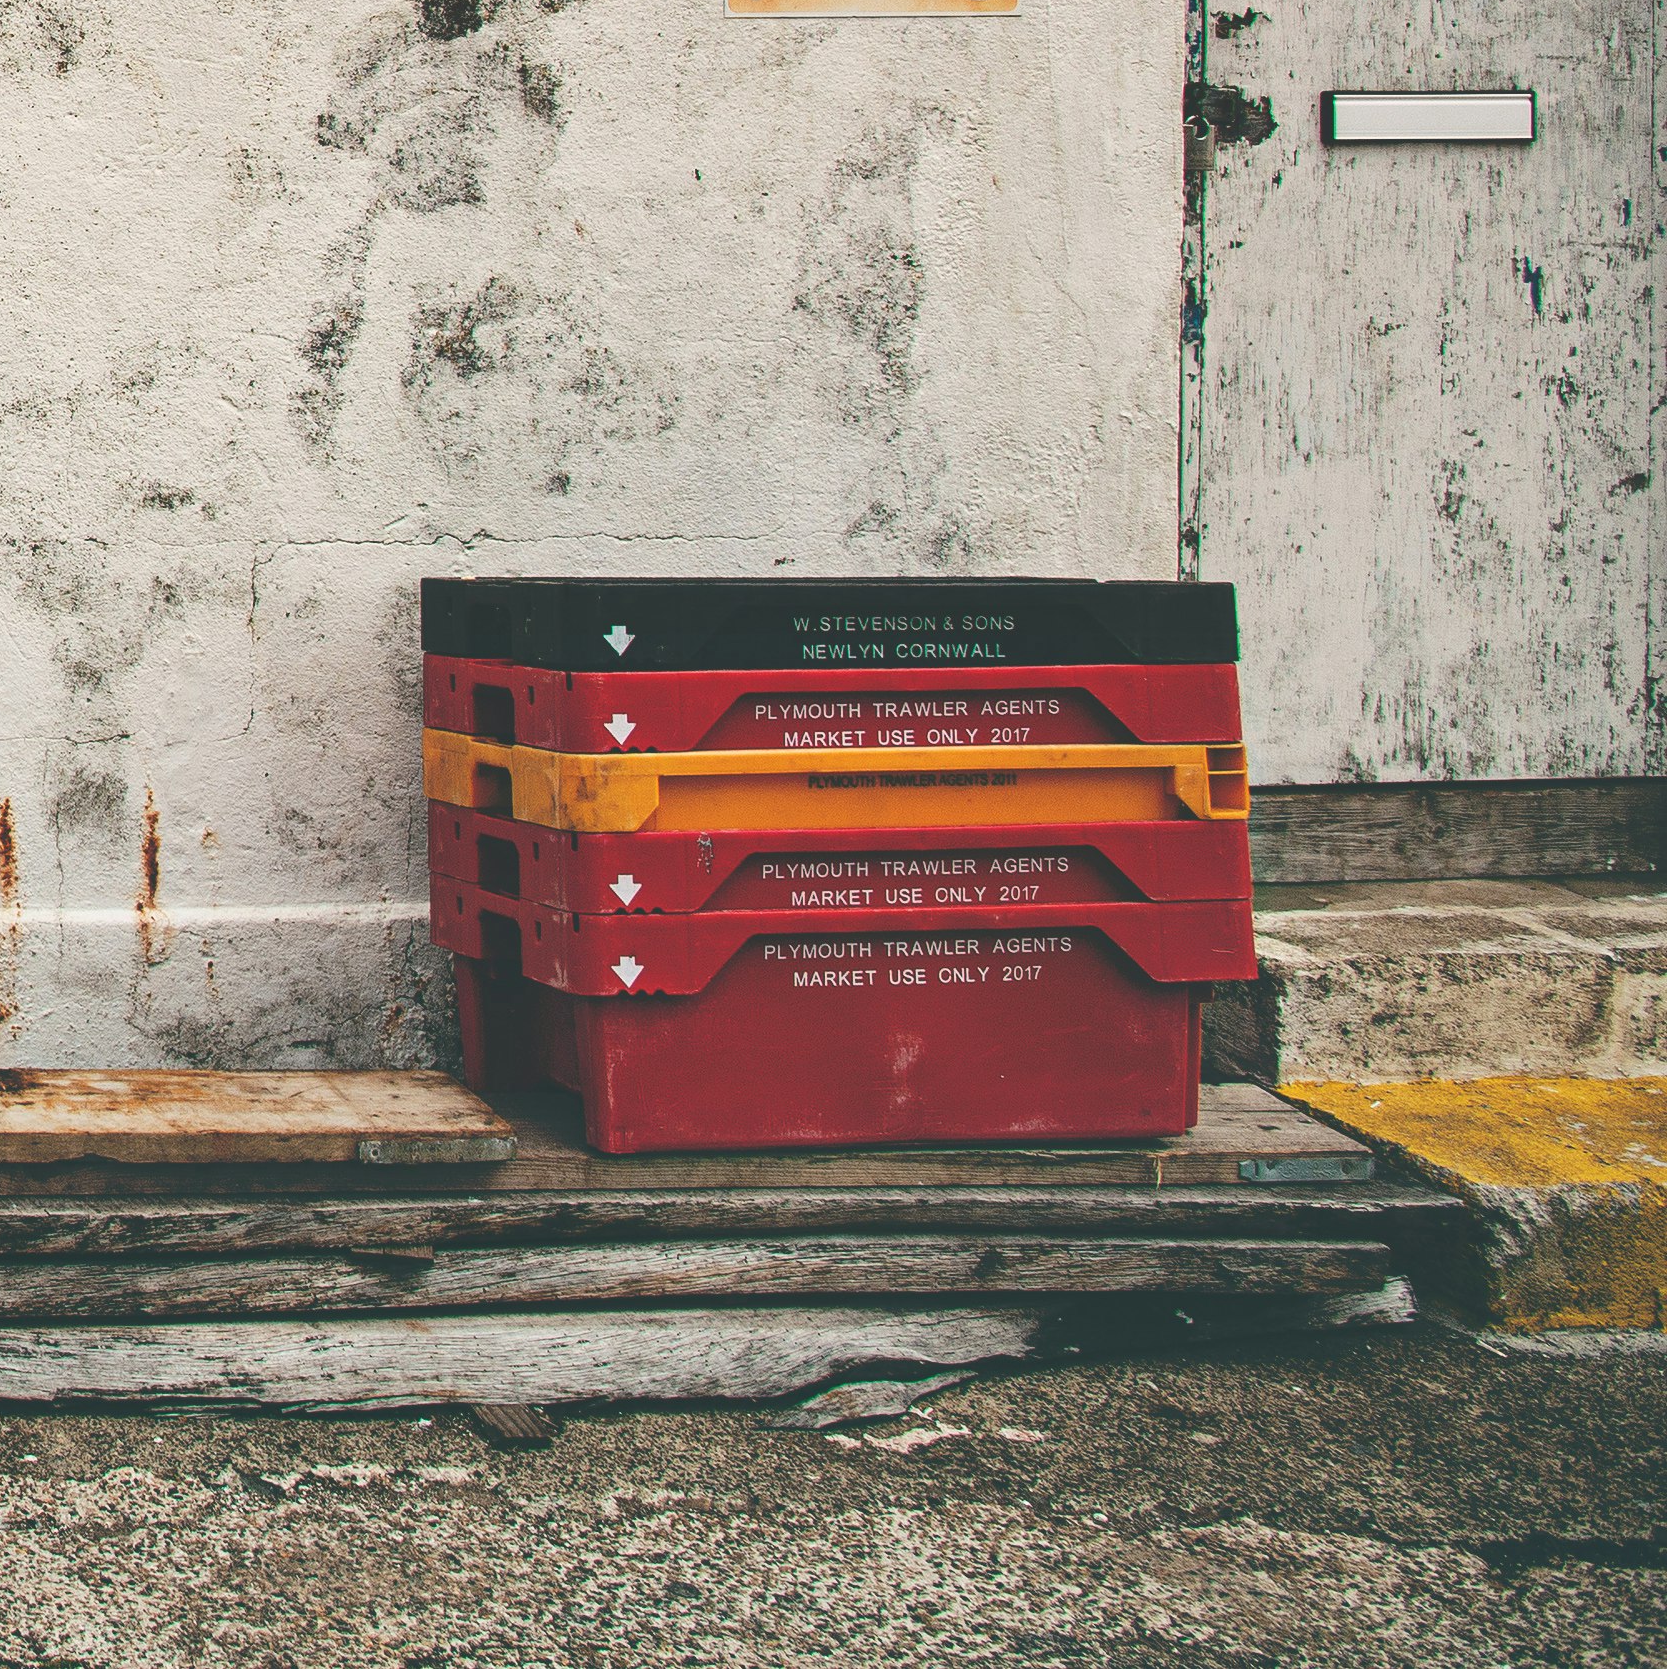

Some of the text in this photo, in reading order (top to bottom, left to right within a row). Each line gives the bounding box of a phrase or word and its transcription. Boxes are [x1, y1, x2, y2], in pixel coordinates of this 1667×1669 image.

[942, 616, 954, 631] &
[961, 615, 1015, 631] SONS
[802, 642, 1006, 660] NEWLYN CORNWALL
[755, 699, 1060, 720] PLYMOUTH TRAWLER AGENTS
[783, 727, 1030, 747] MARKET USE ONLY 2017
[808, 774, 874, 789] PLYMOUTH
[880, 774, 937, 788] TRAWLER
[939, 773, 989, 787] AGENTS
[762, 857, 1069, 879] PLYMOUTH TRAWLER AGENTS
[791, 885, 1040, 906] MARKET USE ONLY 2017
[764, 937, 1072, 960] PLYMOUTH TRAWLER AGENTS
[793, 965, 1043, 987] MARKET USE ONLY 2017
